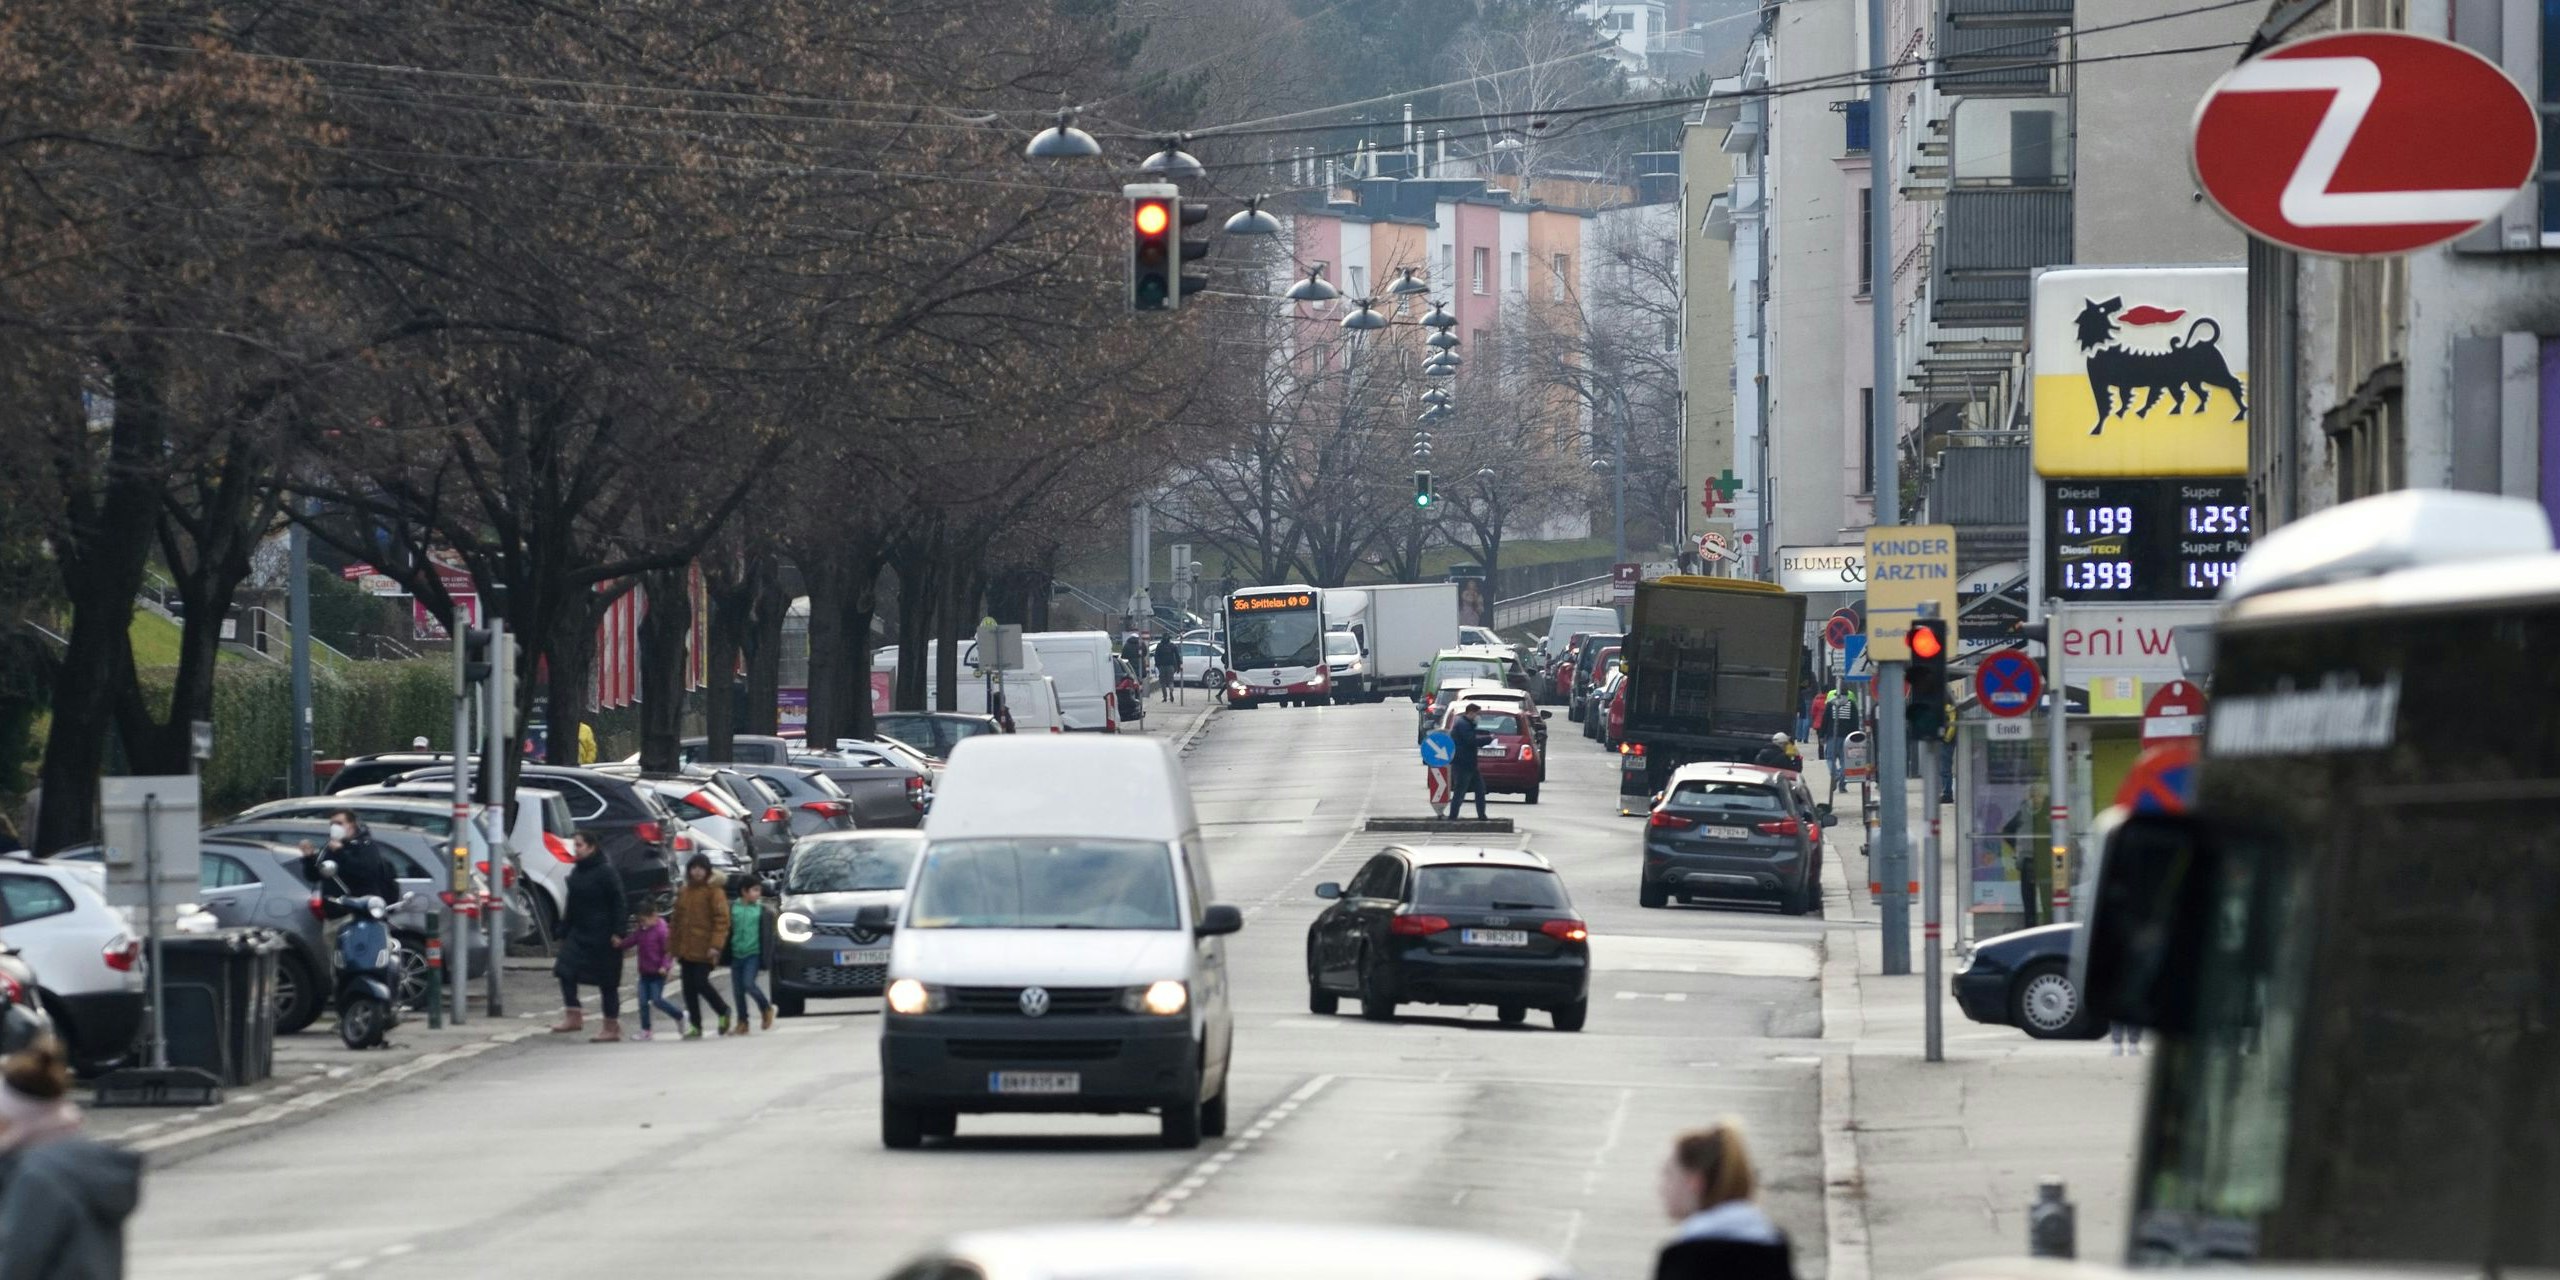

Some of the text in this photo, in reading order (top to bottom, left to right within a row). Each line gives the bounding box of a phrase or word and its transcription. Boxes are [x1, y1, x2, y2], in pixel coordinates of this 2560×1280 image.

[2057, 486, 2100, 499] Diesel
[2181, 486, 2222, 500] Super
[2066, 506, 2132, 535] 1.199
[1871, 538, 1949, 557] KINDER
[2180, 540, 2247, 555] Super Plu
[1874, 561, 1948, 581] ÄRZTIN
[2066, 562, 2132, 590] 1.399
[2189, 562, 2238, 588] 1.44
[1234, 599, 1249, 610] 35A
[1250, 597, 1286, 609] Spittelau
[2063, 616, 2123, 656] eni
[1997, 723, 2022, 735] Ende
